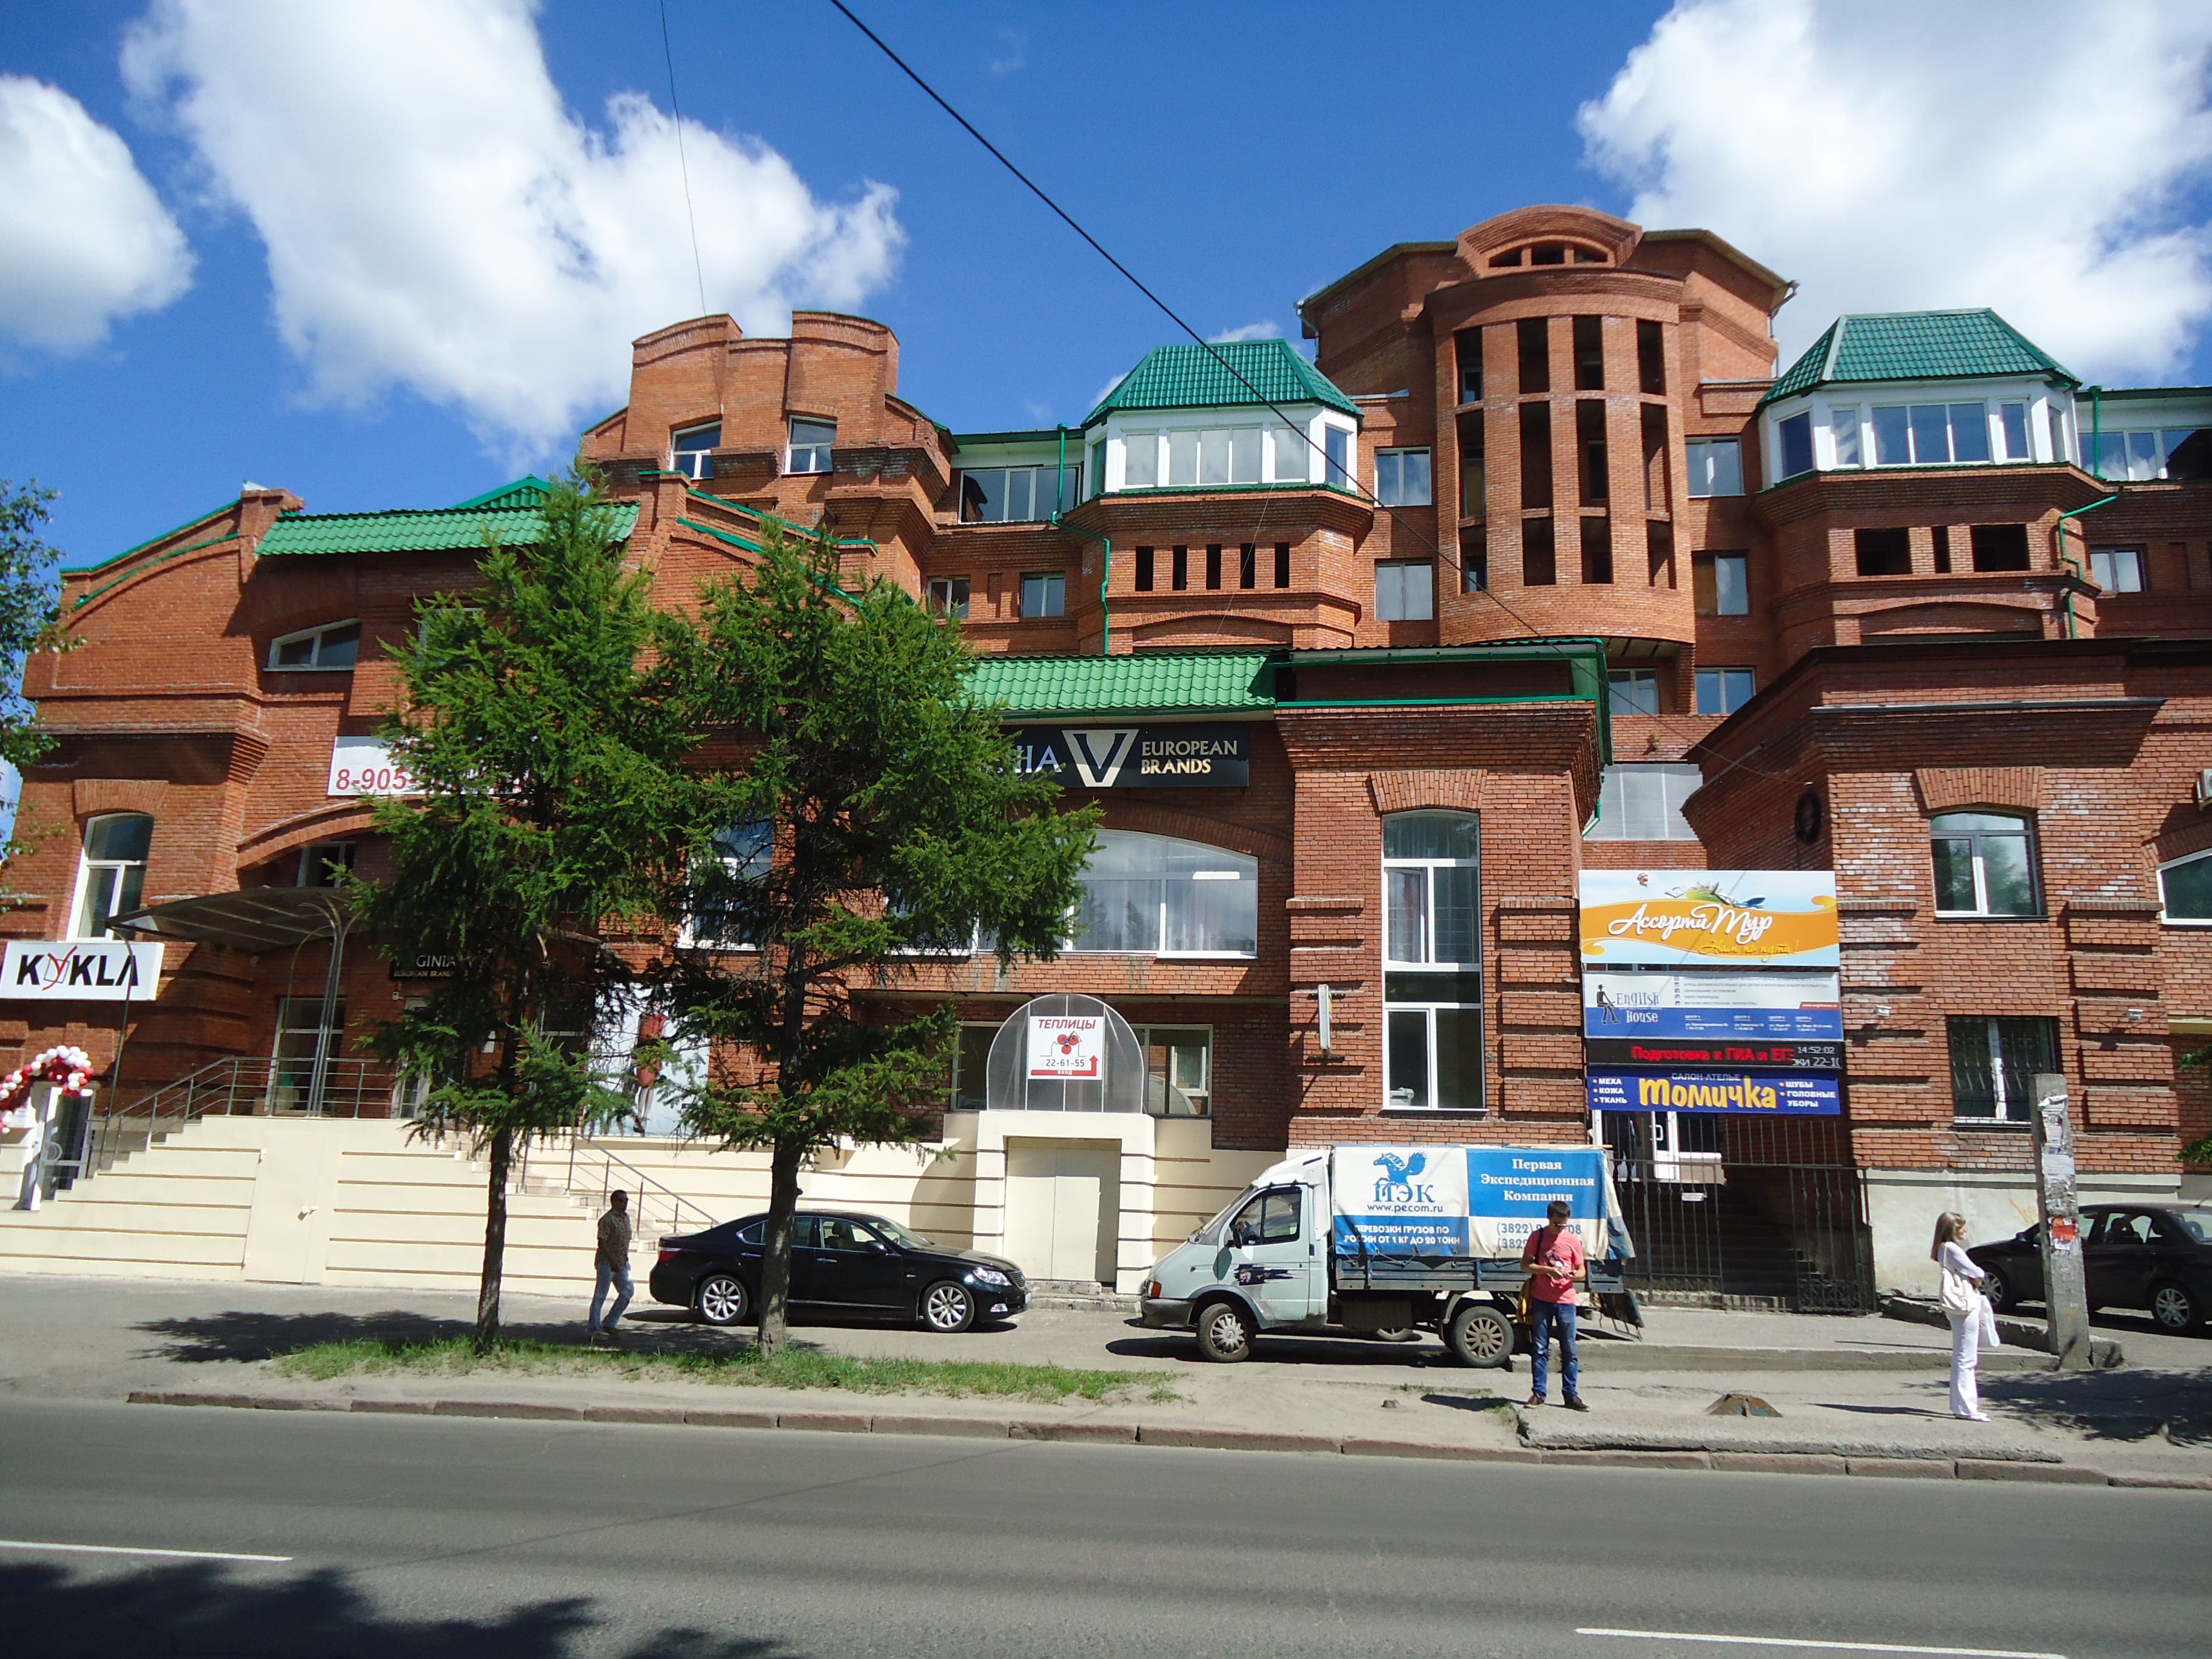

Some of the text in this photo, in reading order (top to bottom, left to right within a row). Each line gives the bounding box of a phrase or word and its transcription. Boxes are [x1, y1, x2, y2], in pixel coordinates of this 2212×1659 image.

[1141, 740, 1238, 757] EUROPEAN
[1141, 758, 1212, 774] BRANDS
[1616, 992, 1659, 1006] English
[1626, 1010, 1659, 1023] House
[1038, 1019, 1096, 1031] ТЕПЛИЦЫ
[1046, 1059, 1085, 1067] 22-61-55
[1512, 1159, 1562, 1171] Первая
[1481, 1174, 1595, 1187] Экспедиционная
[1373, 1183, 1435, 1203] ПЭК
[1504, 1190, 1574, 1202] Компания
[1367, 1204, 1443, 1213] www.pecom.ru
[1403, 1225, 1435, 1234] ГРУЗОВ
[1410, 1236, 1424, 1245] ДО
